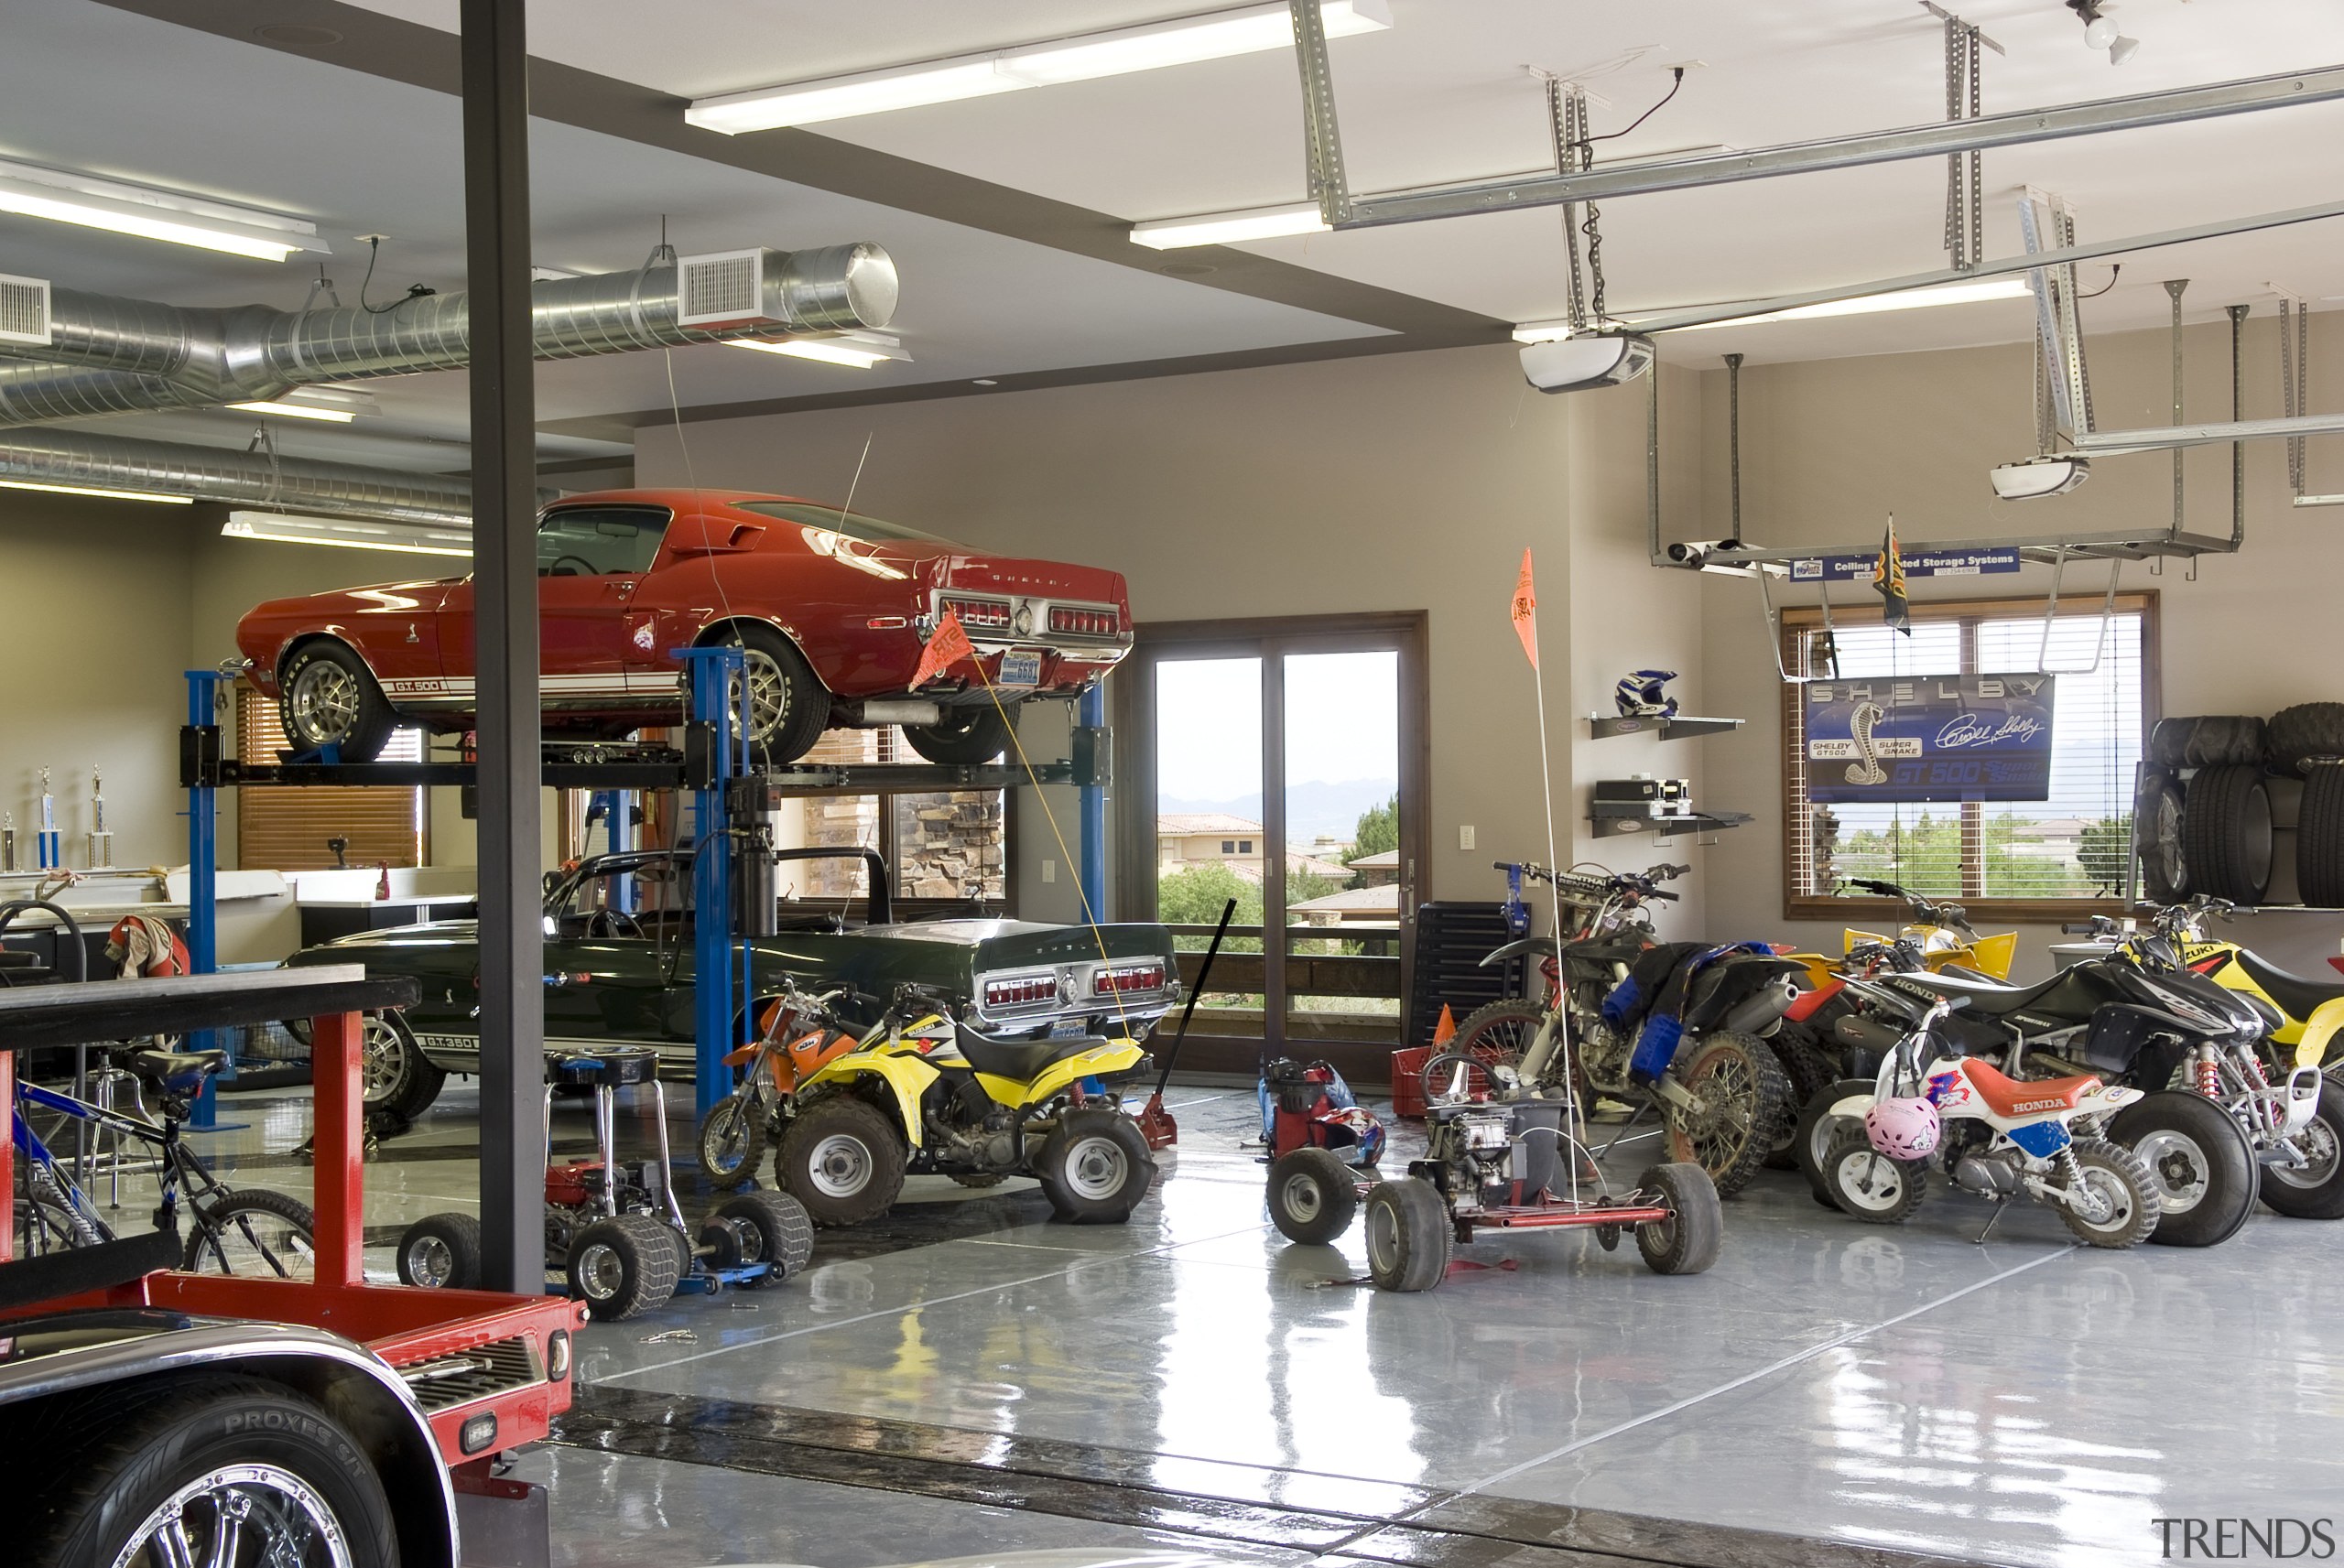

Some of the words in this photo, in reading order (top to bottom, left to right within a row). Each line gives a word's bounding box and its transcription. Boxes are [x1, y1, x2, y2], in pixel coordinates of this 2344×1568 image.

[1835, 561, 1871, 571] Ceiling
[1923, 557, 1965, 568] Storage
[1968, 555, 2014, 566] Systems
[1017, 662, 1038, 678] 6681
[349, 673, 360, 723] EAGLE
[1811, 678, 2045, 703] SHELBY
[777, 676, 792, 730] EAGLE
[1994, 715, 2046, 743] Shelby
[1895, 762, 1928, 784] GT
[1929, 761, 1981, 784] 500
[2179, 945, 2214, 960] ZUKI
[1894, 978, 1937, 1000] HOND
[906, 1023, 936, 1037] SUZUKI
[798, 1040, 816, 1051] KTM
[2012, 1098, 2067, 1113] HONDA
[224, 1410, 331, 1447] PROXES
[334, 1444, 366, 1479] S/T
